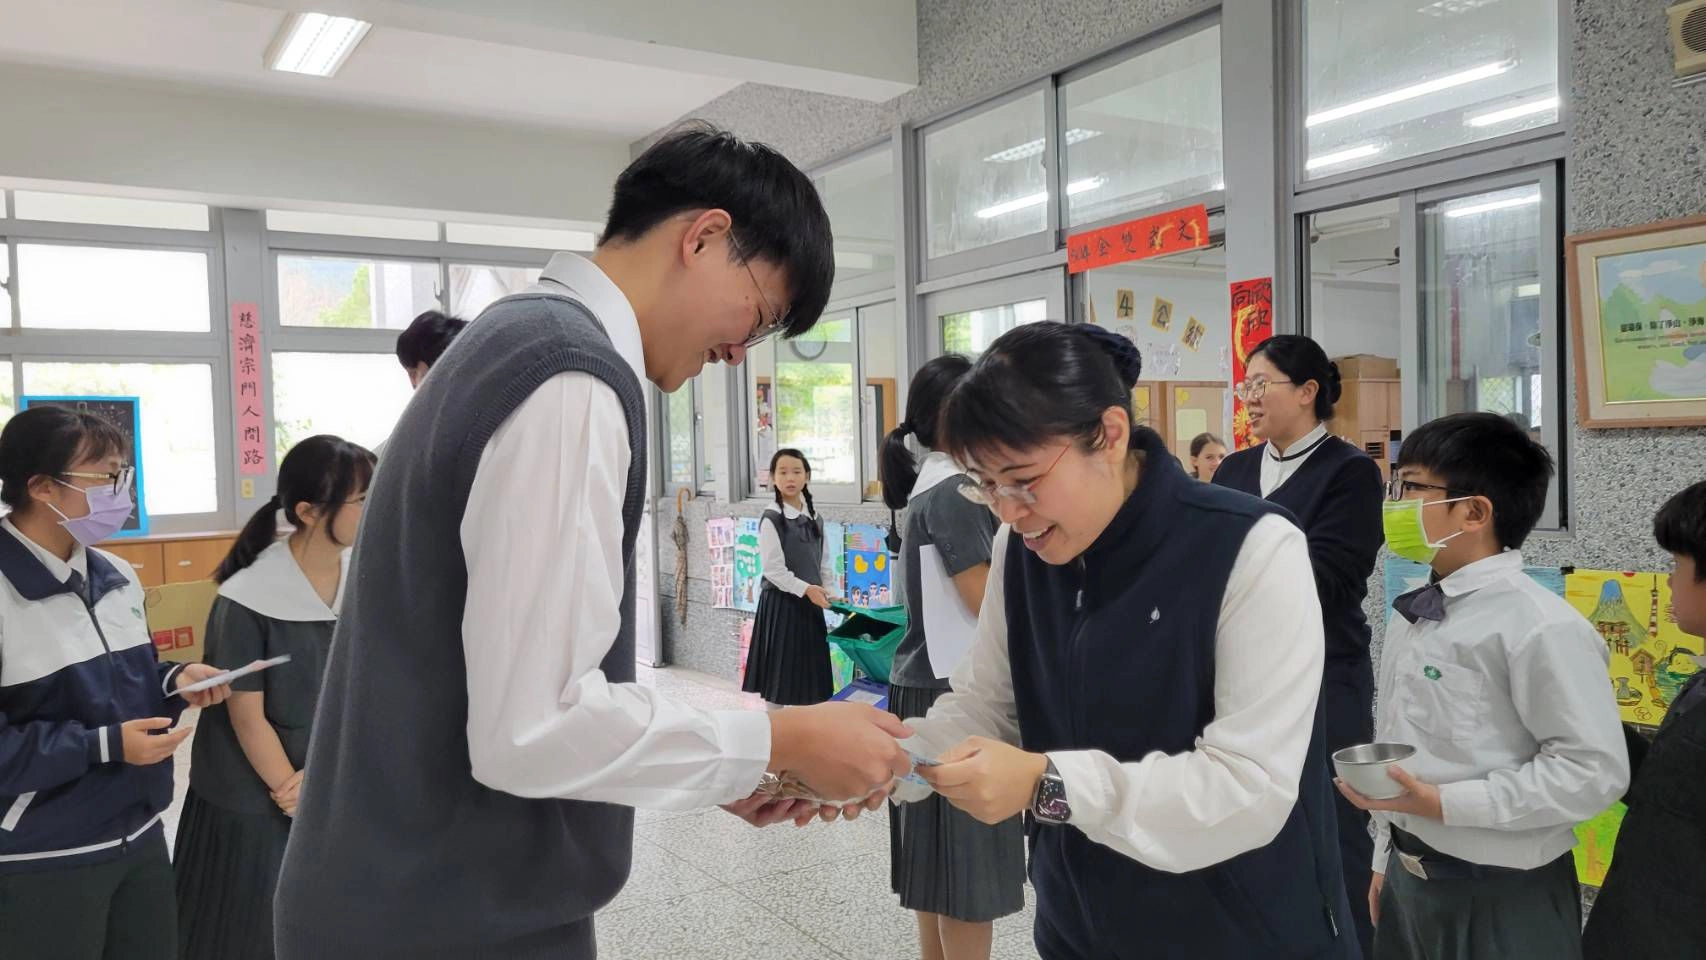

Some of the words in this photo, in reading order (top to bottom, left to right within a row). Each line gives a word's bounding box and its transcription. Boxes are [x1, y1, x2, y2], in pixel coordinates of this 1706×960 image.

[239, 312, 264, 465] 慈濟宗門人間路
